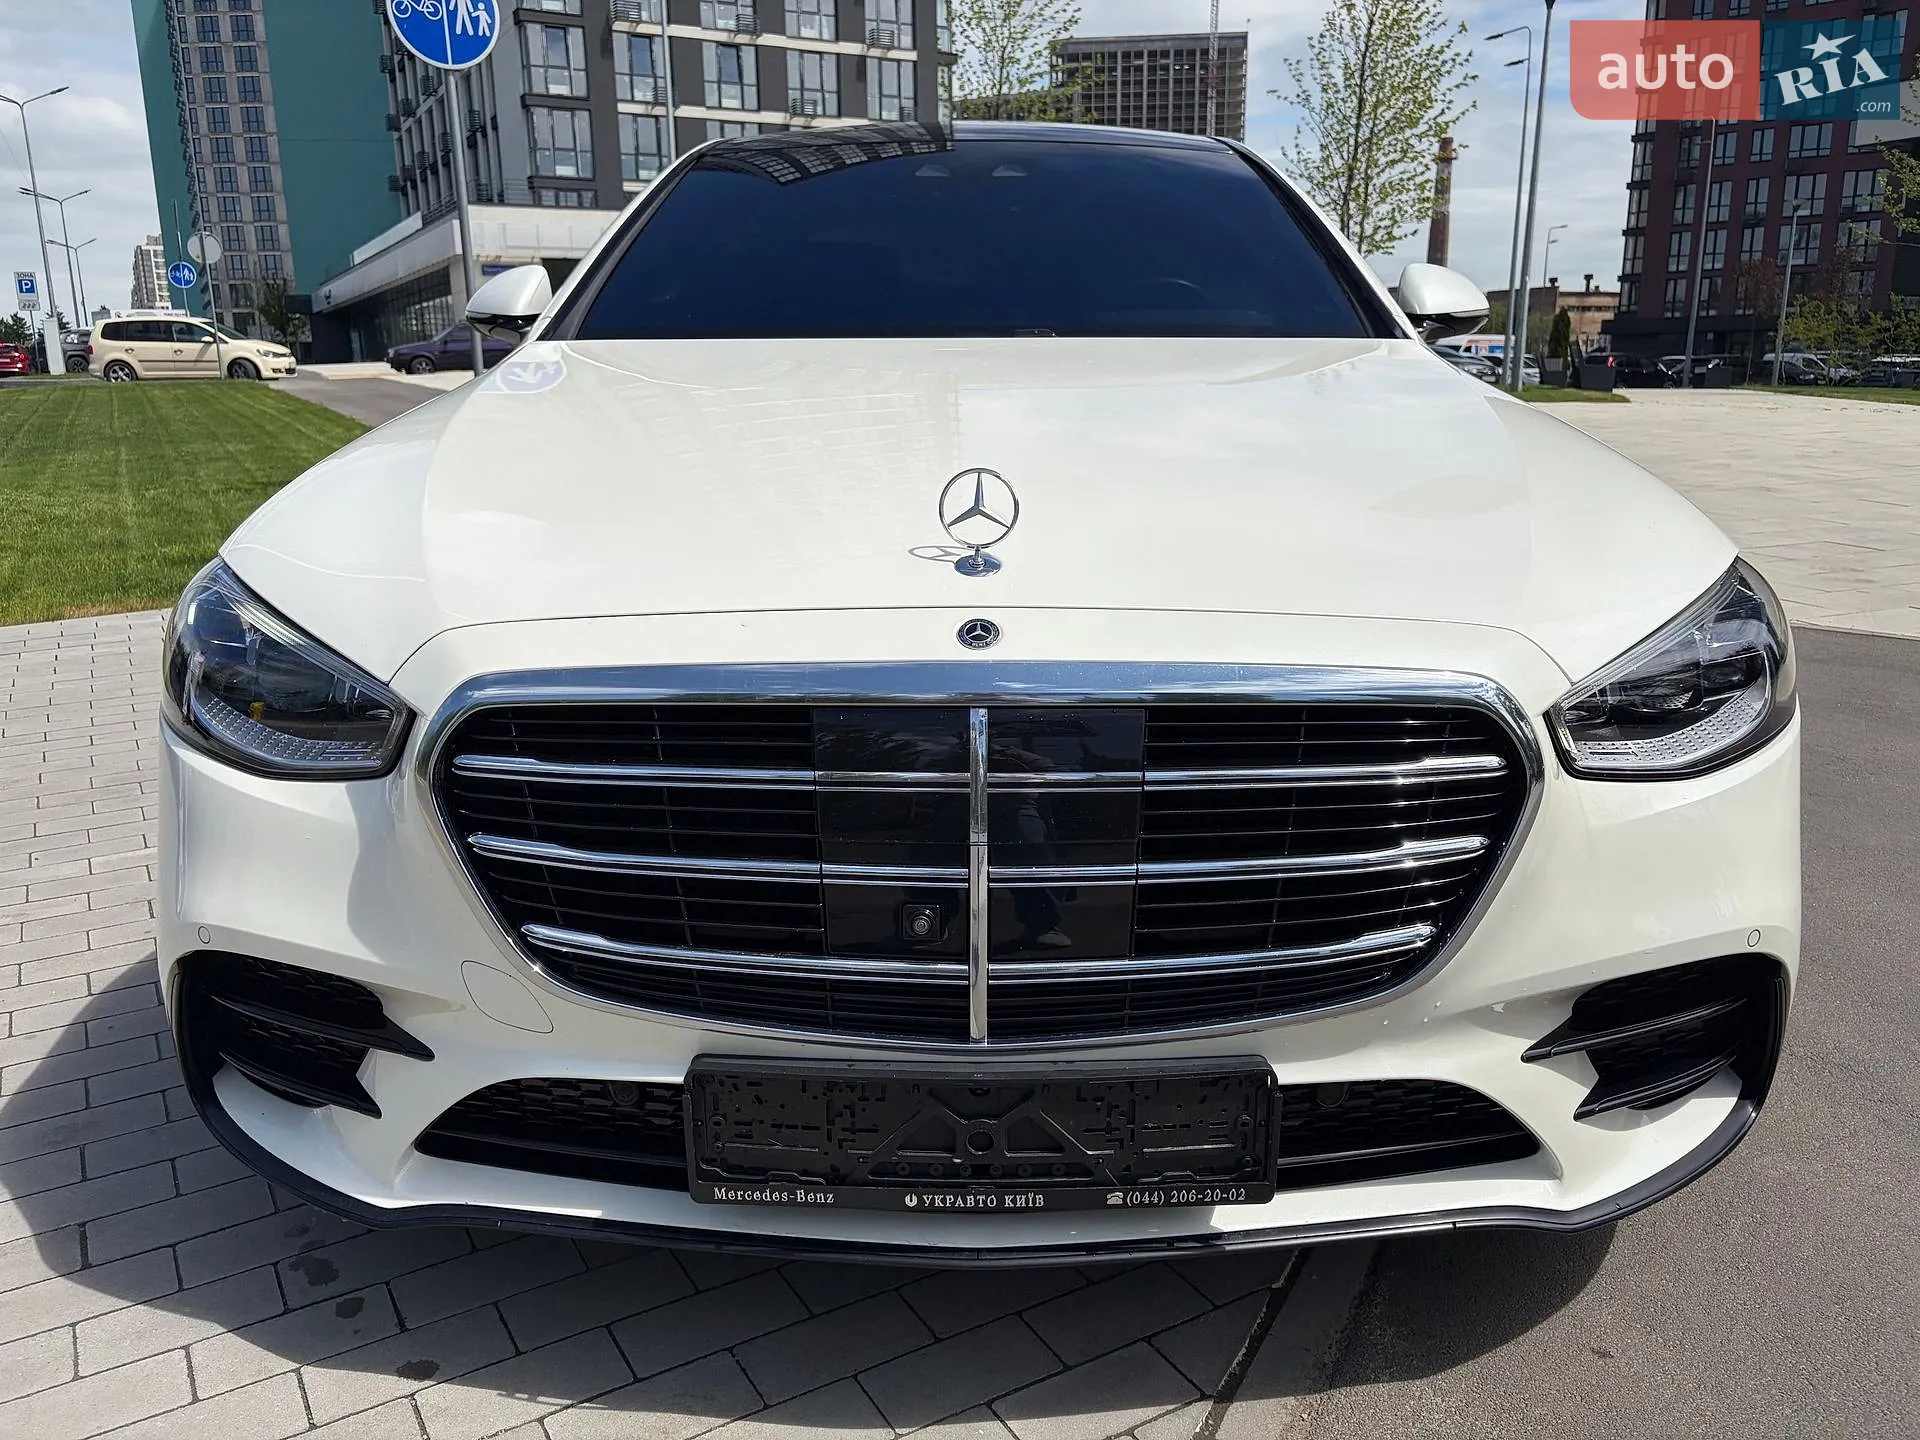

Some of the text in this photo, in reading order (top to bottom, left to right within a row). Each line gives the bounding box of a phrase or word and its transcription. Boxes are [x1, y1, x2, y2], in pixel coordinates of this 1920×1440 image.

[22, 280, 32, 293] P
[713, 1187, 835, 1203] Mercedes-Benz
[922, 1192, 1044, 1207] УКРАВТО КИЇВ
[1126, 1188, 1246, 1206] (044) 206-20-02
